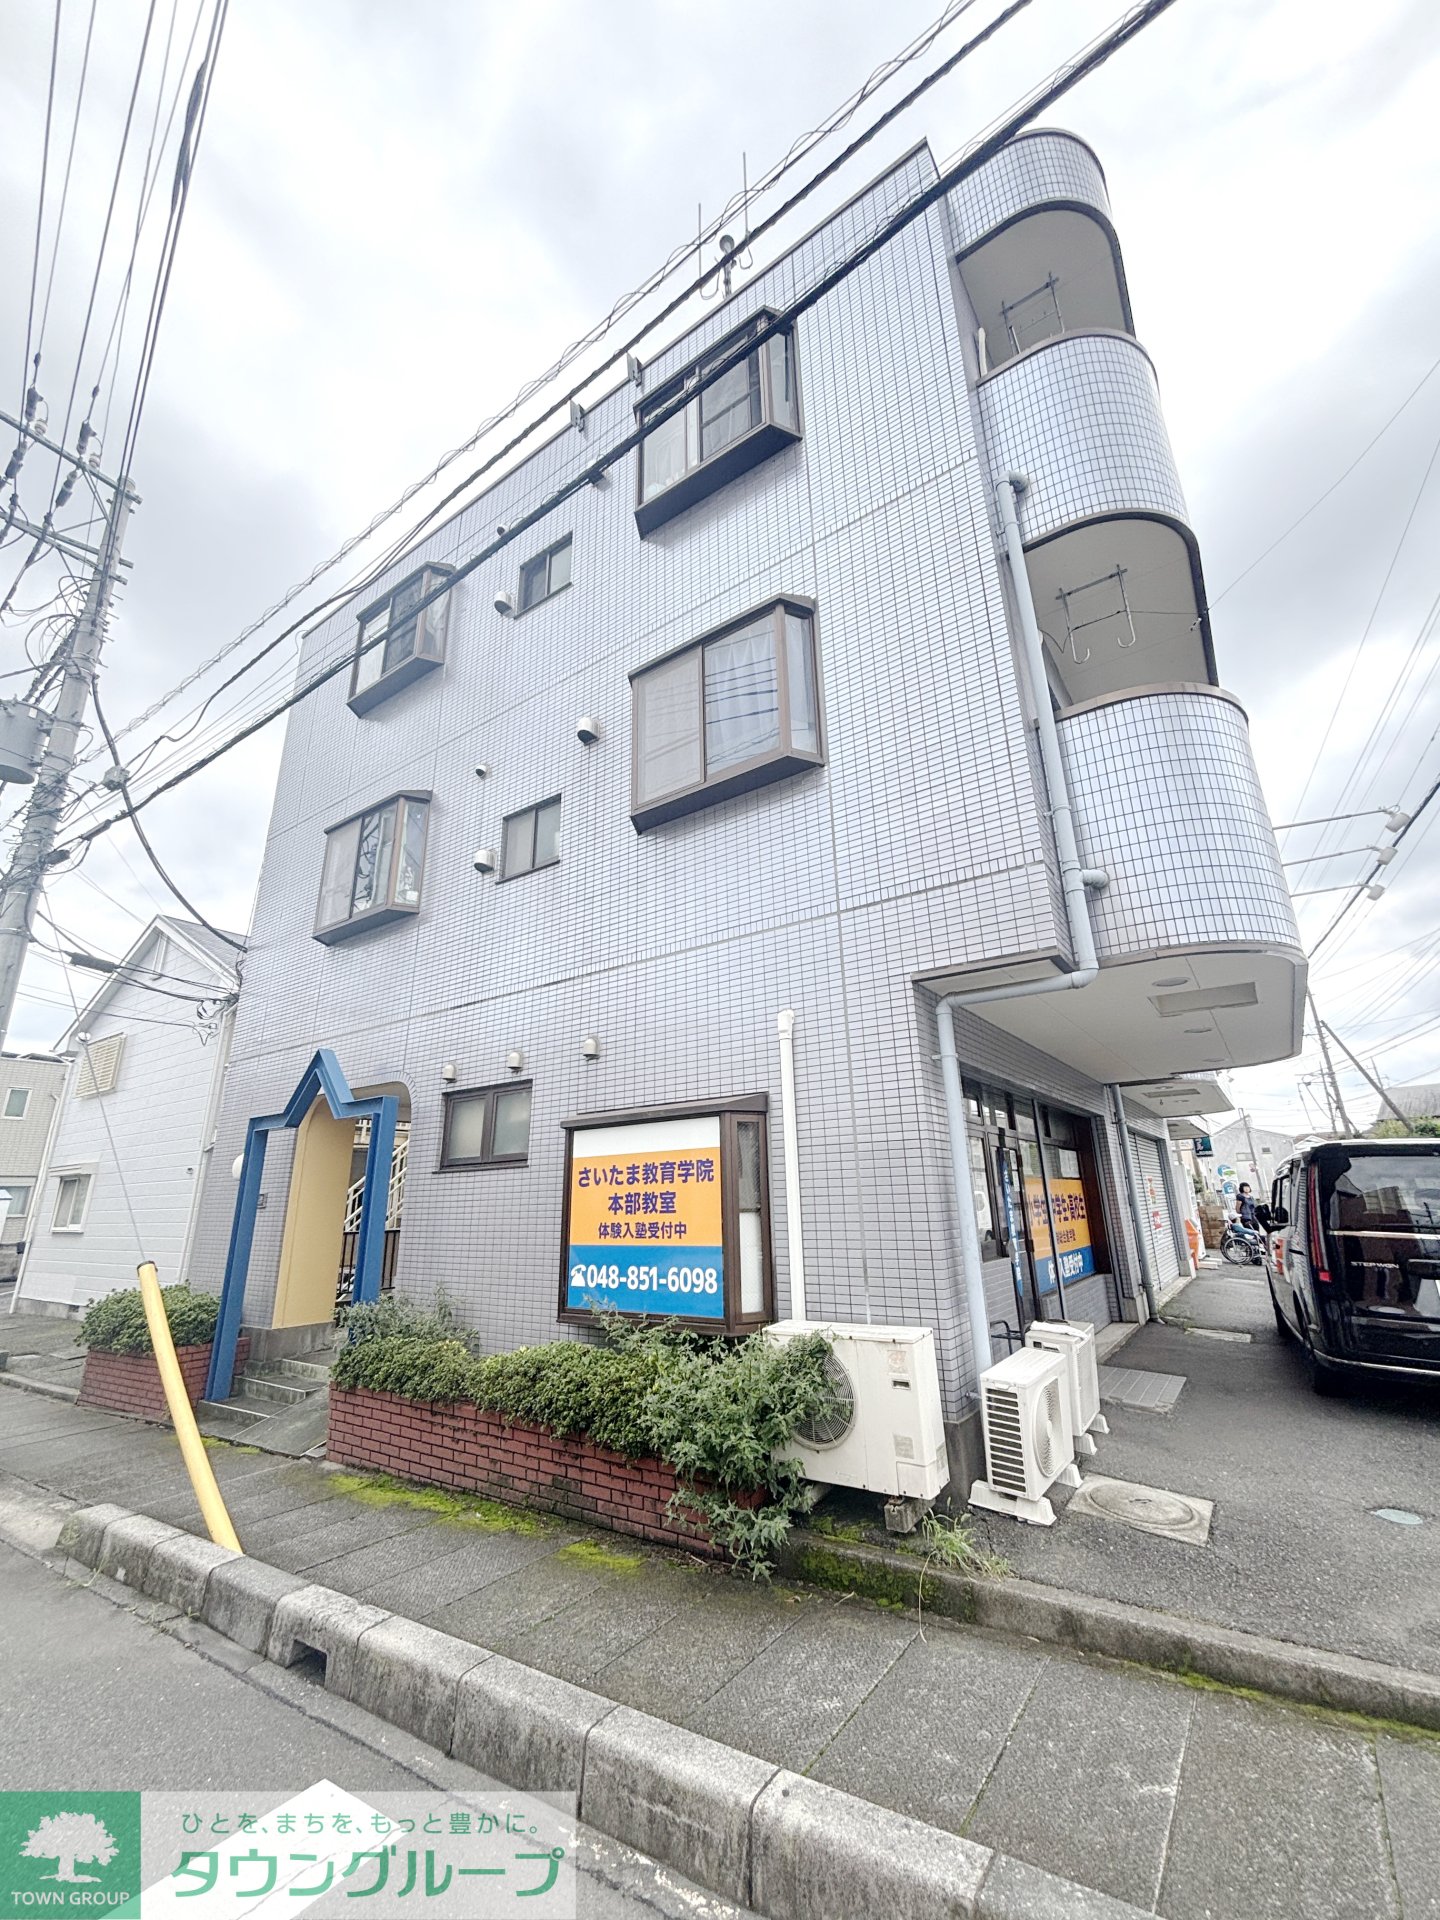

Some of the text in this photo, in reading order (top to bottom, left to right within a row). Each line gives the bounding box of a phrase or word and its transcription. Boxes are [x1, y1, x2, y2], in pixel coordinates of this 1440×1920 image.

[578, 1158, 715, 1188] さいたま教育学院
[608, 1191, 677, 1216] 本部教室
[598, 1221, 688, 1240] 体験入塾受付中
[586, 1264, 718, 1294] 048-851-6098
[1047, 1252, 1084, 1284] 体入塾受付中
